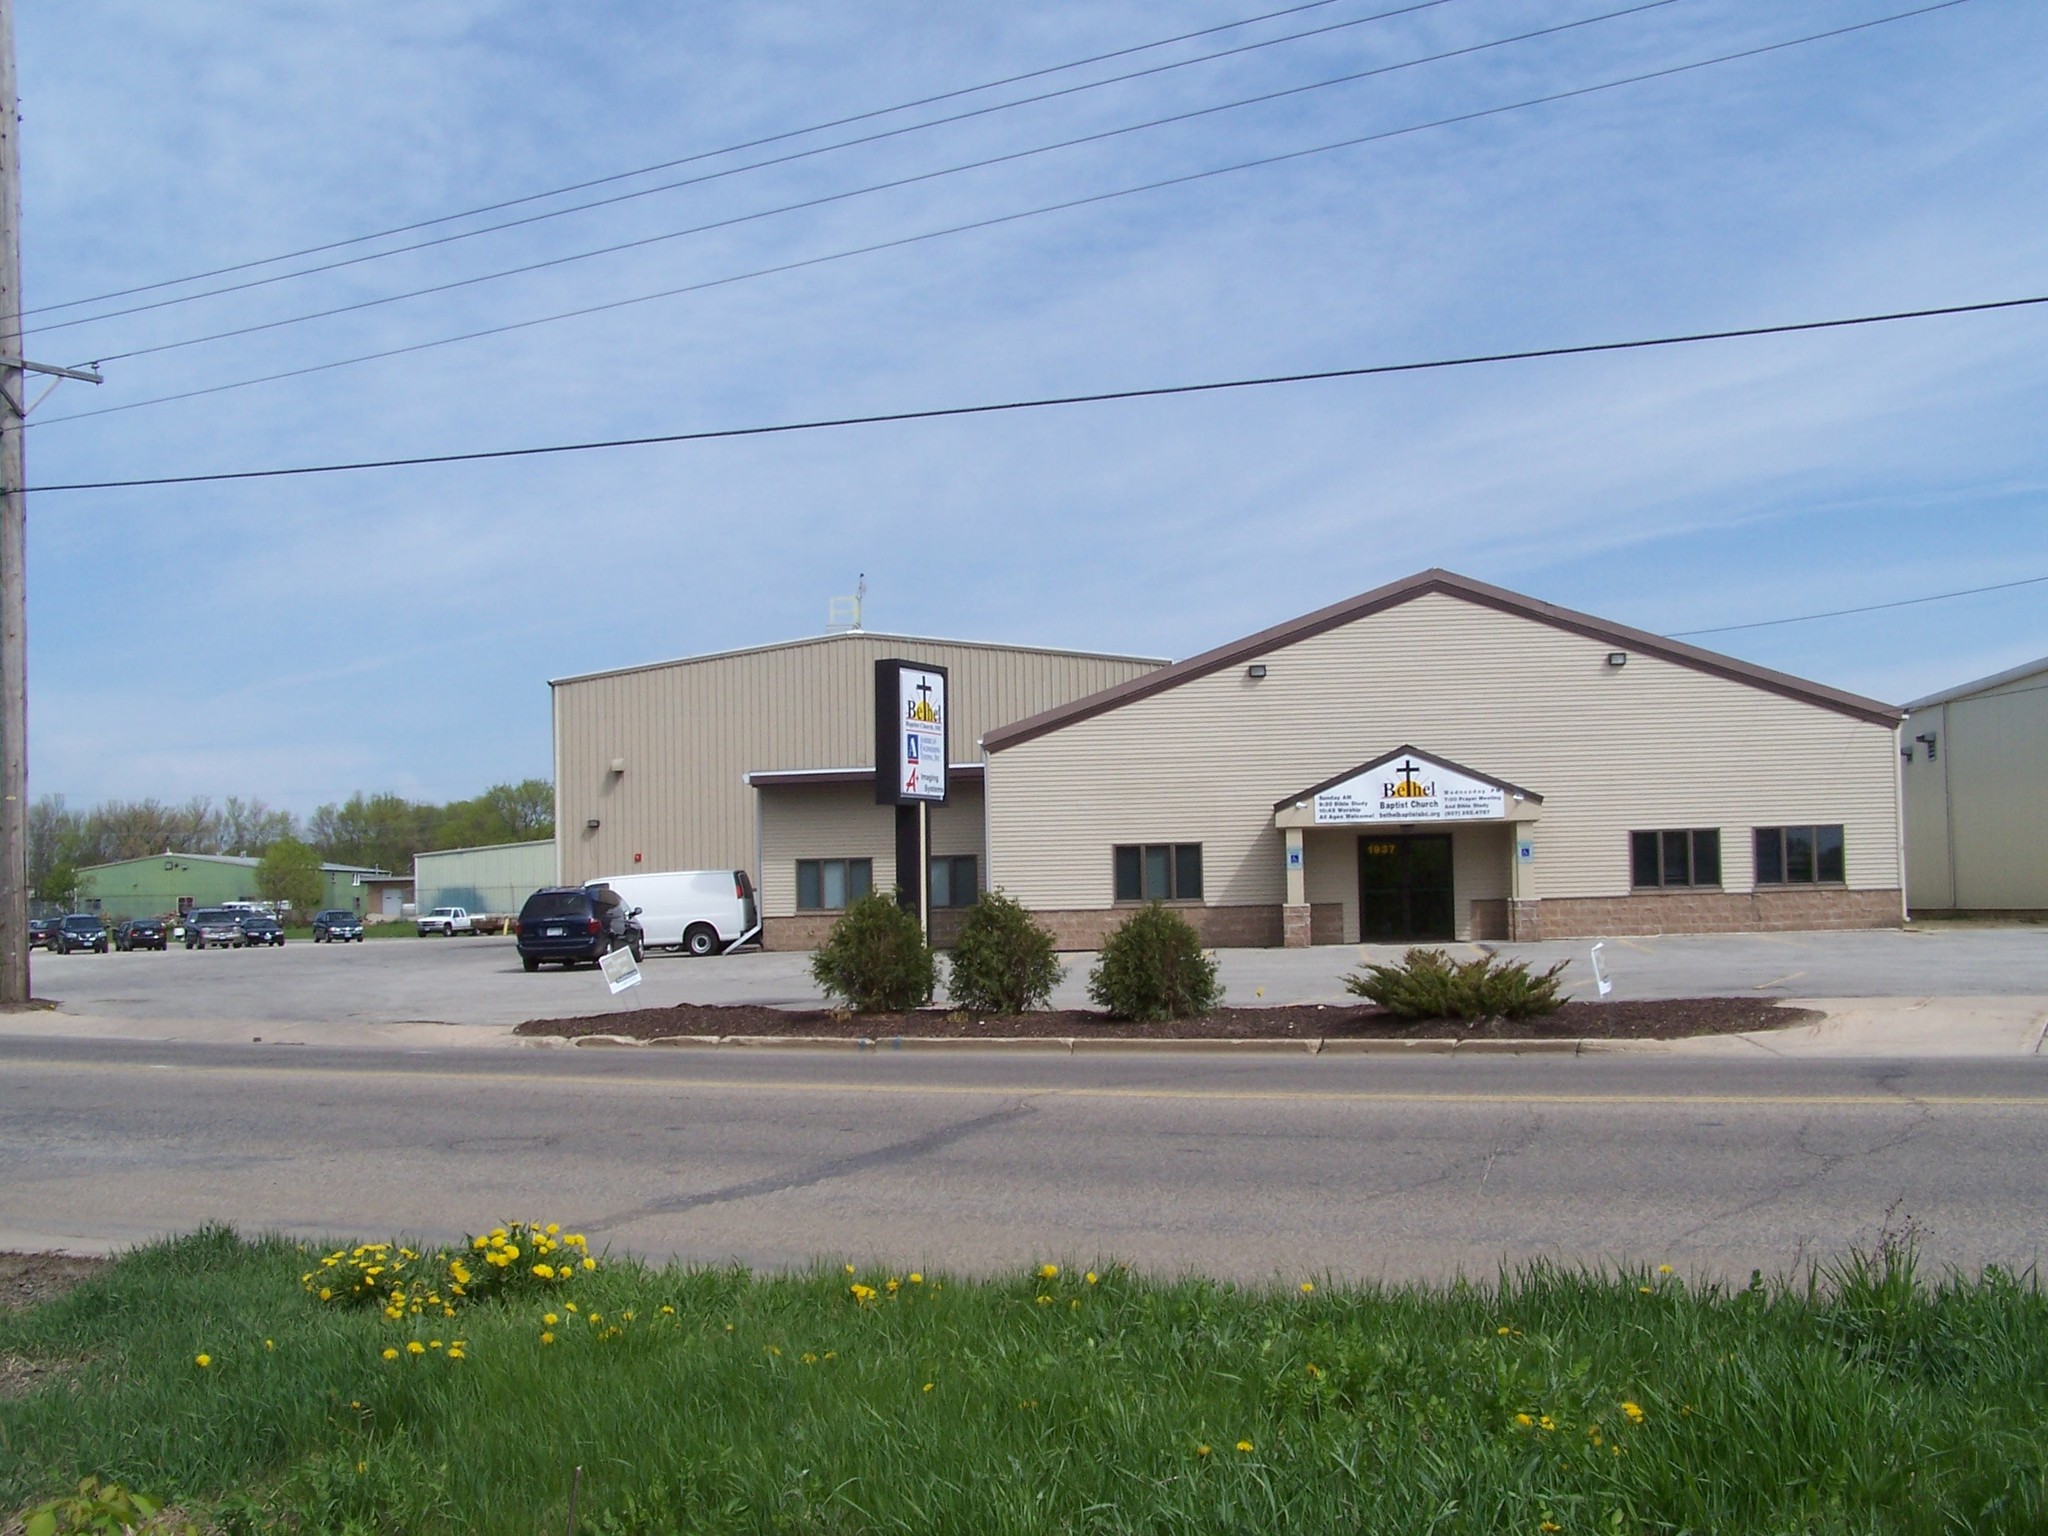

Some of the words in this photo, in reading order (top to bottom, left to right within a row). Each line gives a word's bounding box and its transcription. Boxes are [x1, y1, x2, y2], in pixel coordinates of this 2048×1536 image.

[907, 699, 942, 724] Bethel
[920, 773, 939, 783] Imaging
[924, 784, 944, 794] Systems
[1383, 780, 1436, 798] Bethel
[1379, 801, 1408, 810] Baptist
[1410, 799, 1439, 809] Church
[1367, 843, 1397, 855] 1937
